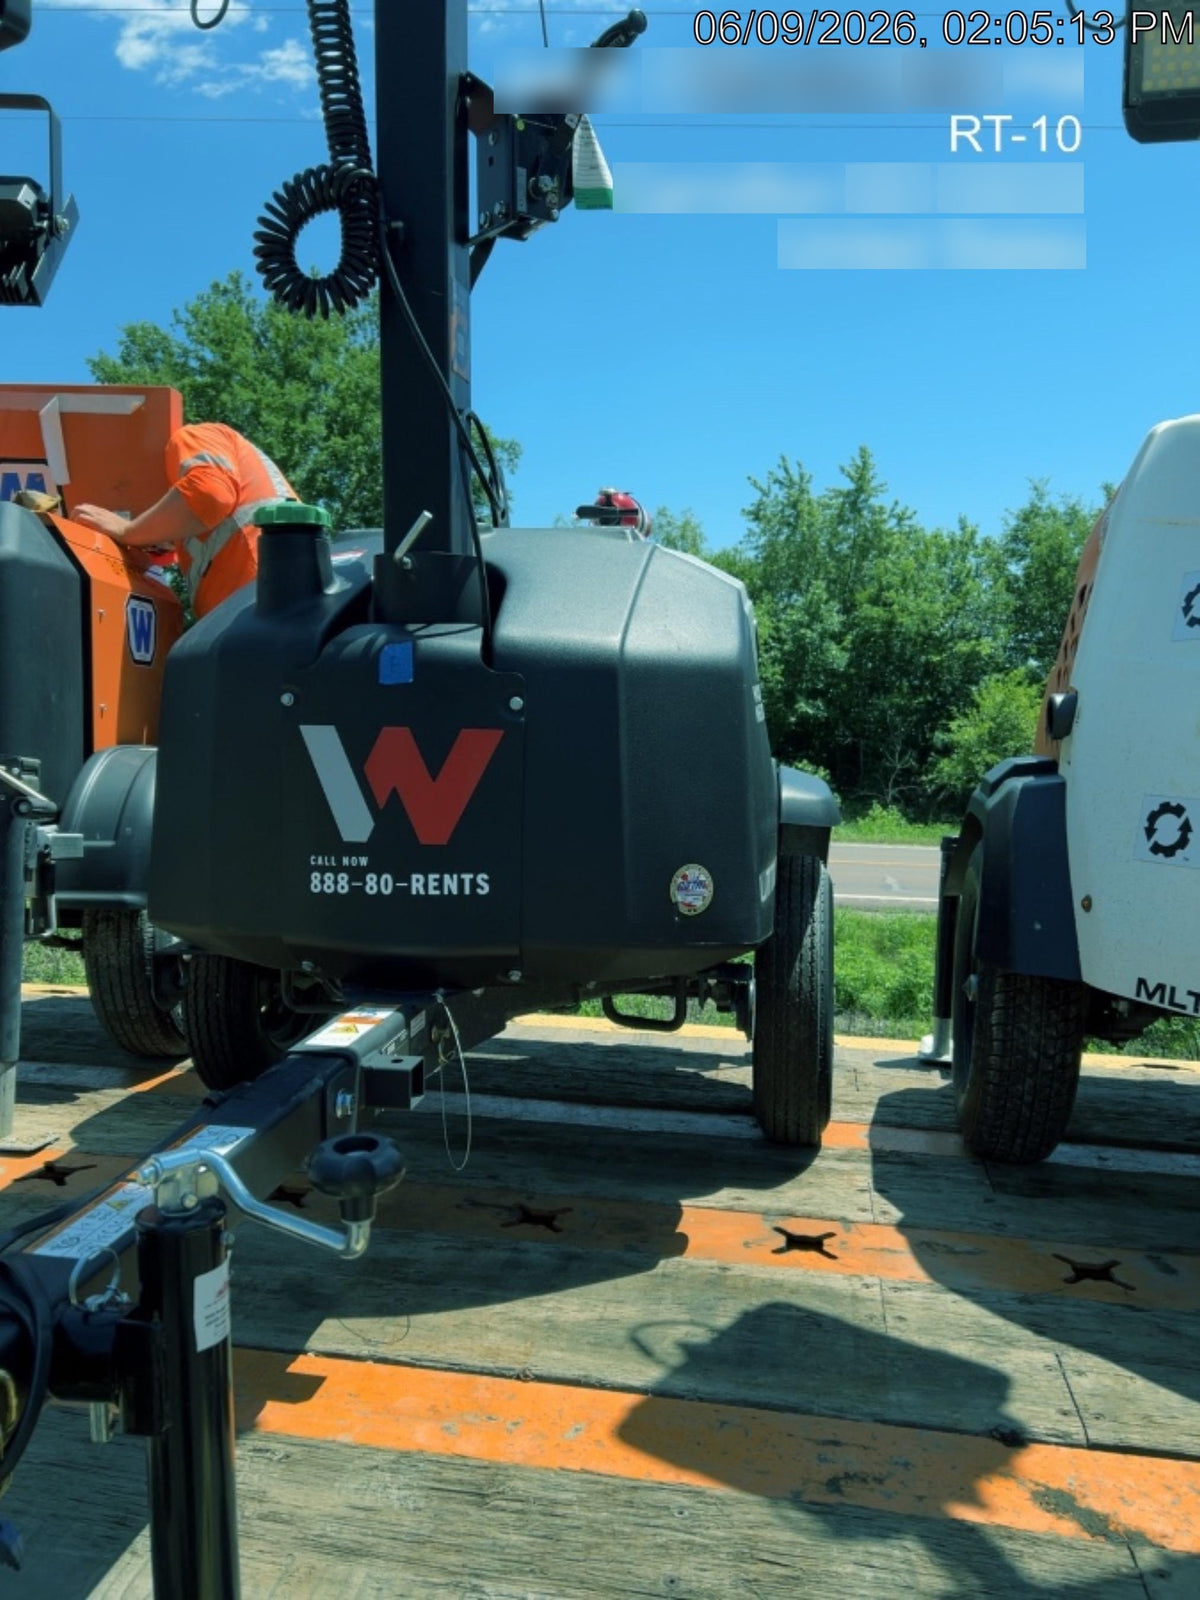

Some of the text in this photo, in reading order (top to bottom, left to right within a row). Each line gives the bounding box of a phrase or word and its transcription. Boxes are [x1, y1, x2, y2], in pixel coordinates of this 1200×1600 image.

[131, 607, 153, 654] W
[310, 855, 369, 867] CALL NOW
[310, 872, 490, 895] 888-80-RENTS
